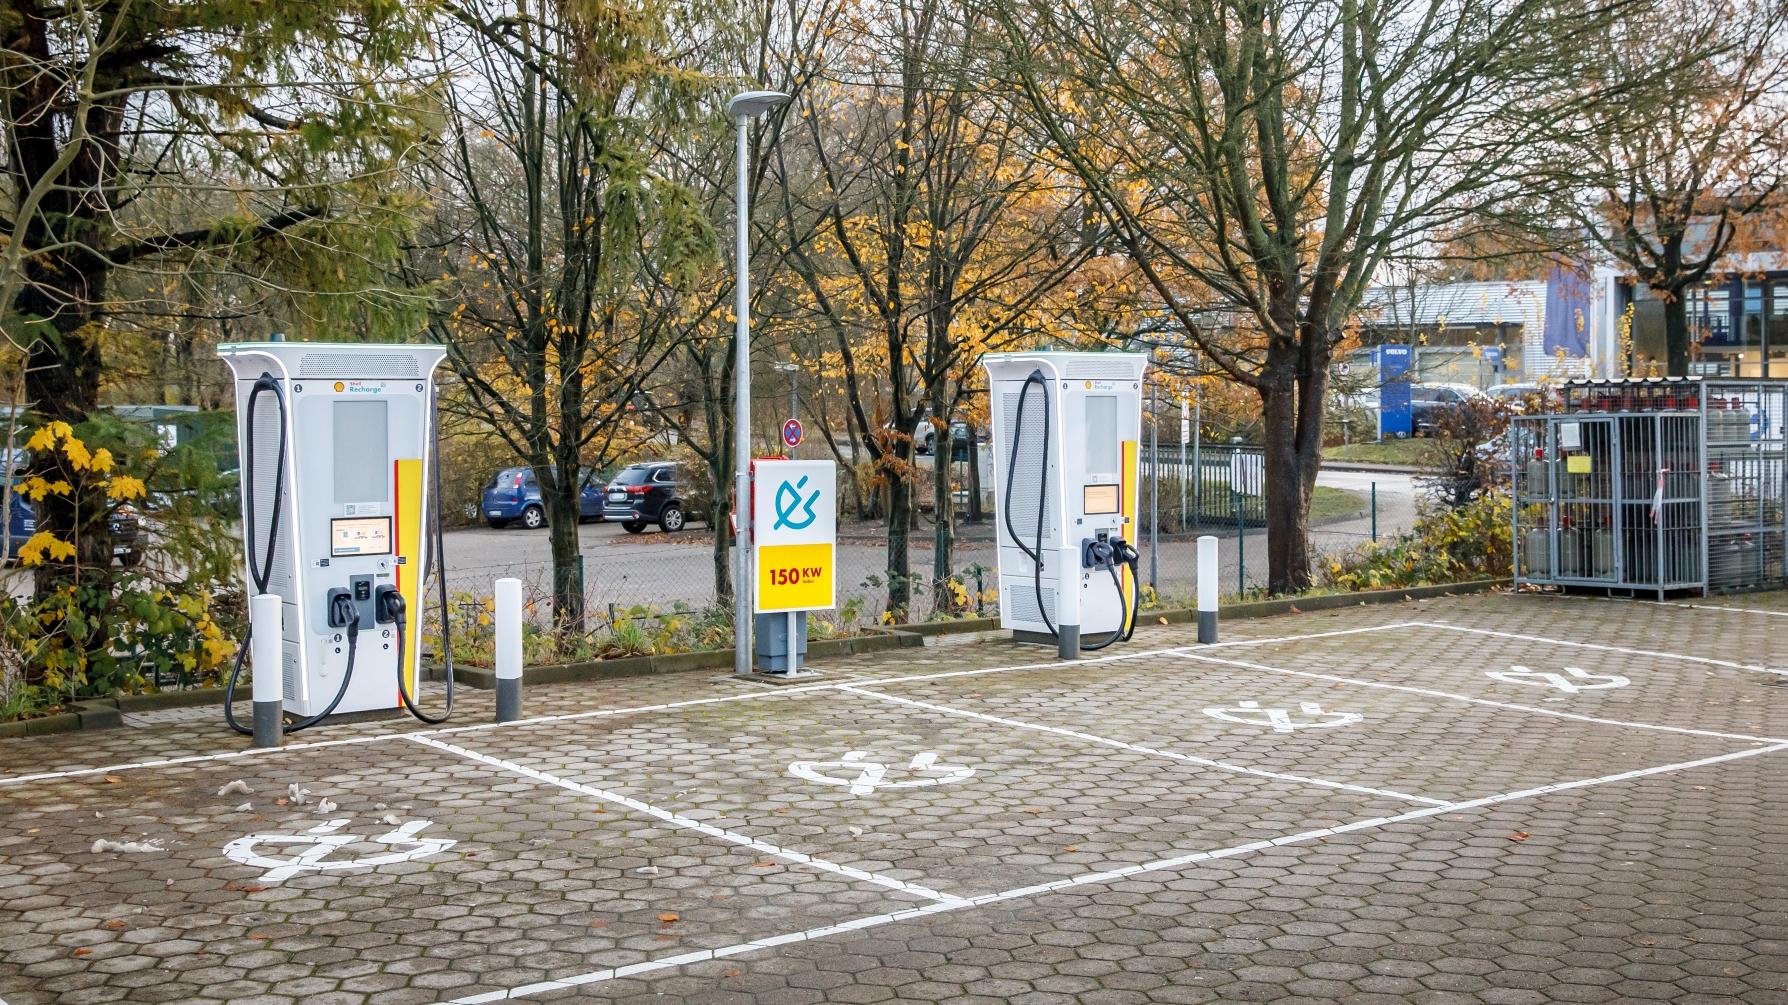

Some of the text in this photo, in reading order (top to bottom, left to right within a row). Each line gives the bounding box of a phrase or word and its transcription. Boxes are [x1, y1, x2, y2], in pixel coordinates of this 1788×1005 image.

[350, 386, 381, 394] Recharge
[770, 567, 822, 585] 150 KW
